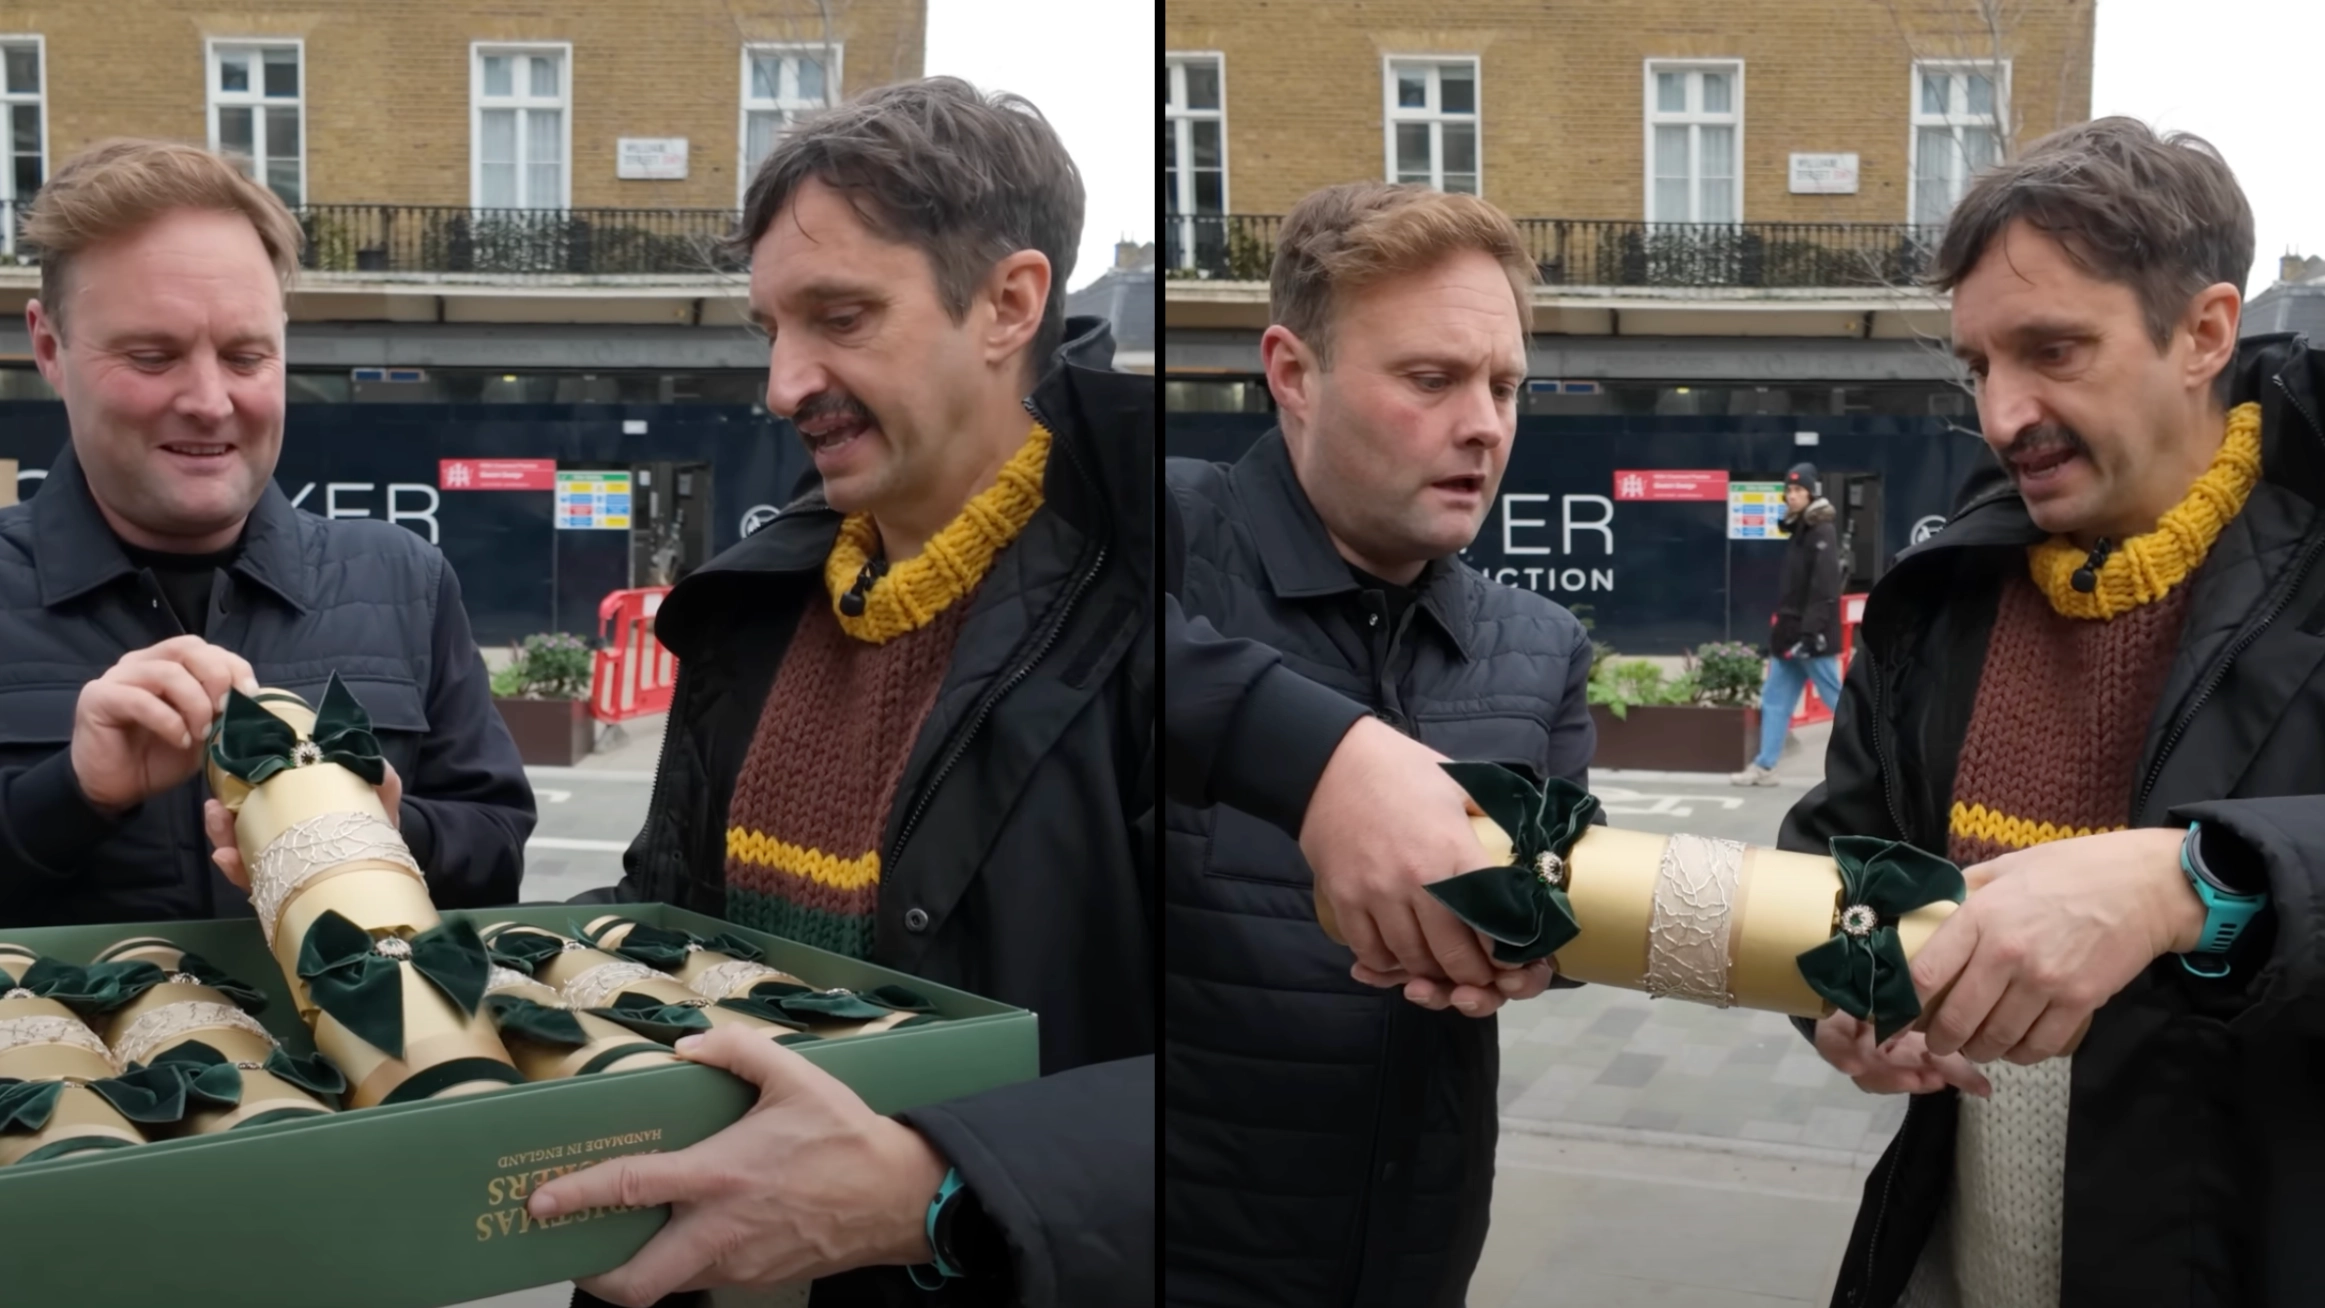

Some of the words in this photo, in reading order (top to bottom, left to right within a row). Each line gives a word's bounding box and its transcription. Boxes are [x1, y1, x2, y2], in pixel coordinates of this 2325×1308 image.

[1459, 493, 1614, 555] ER
[1482, 567, 1614, 592] CTION
[566, 1142, 583, 1157] IN
[585, 1128, 663, 1152] HANDMADE
[497, 1148, 564, 1169] ENGLAND
